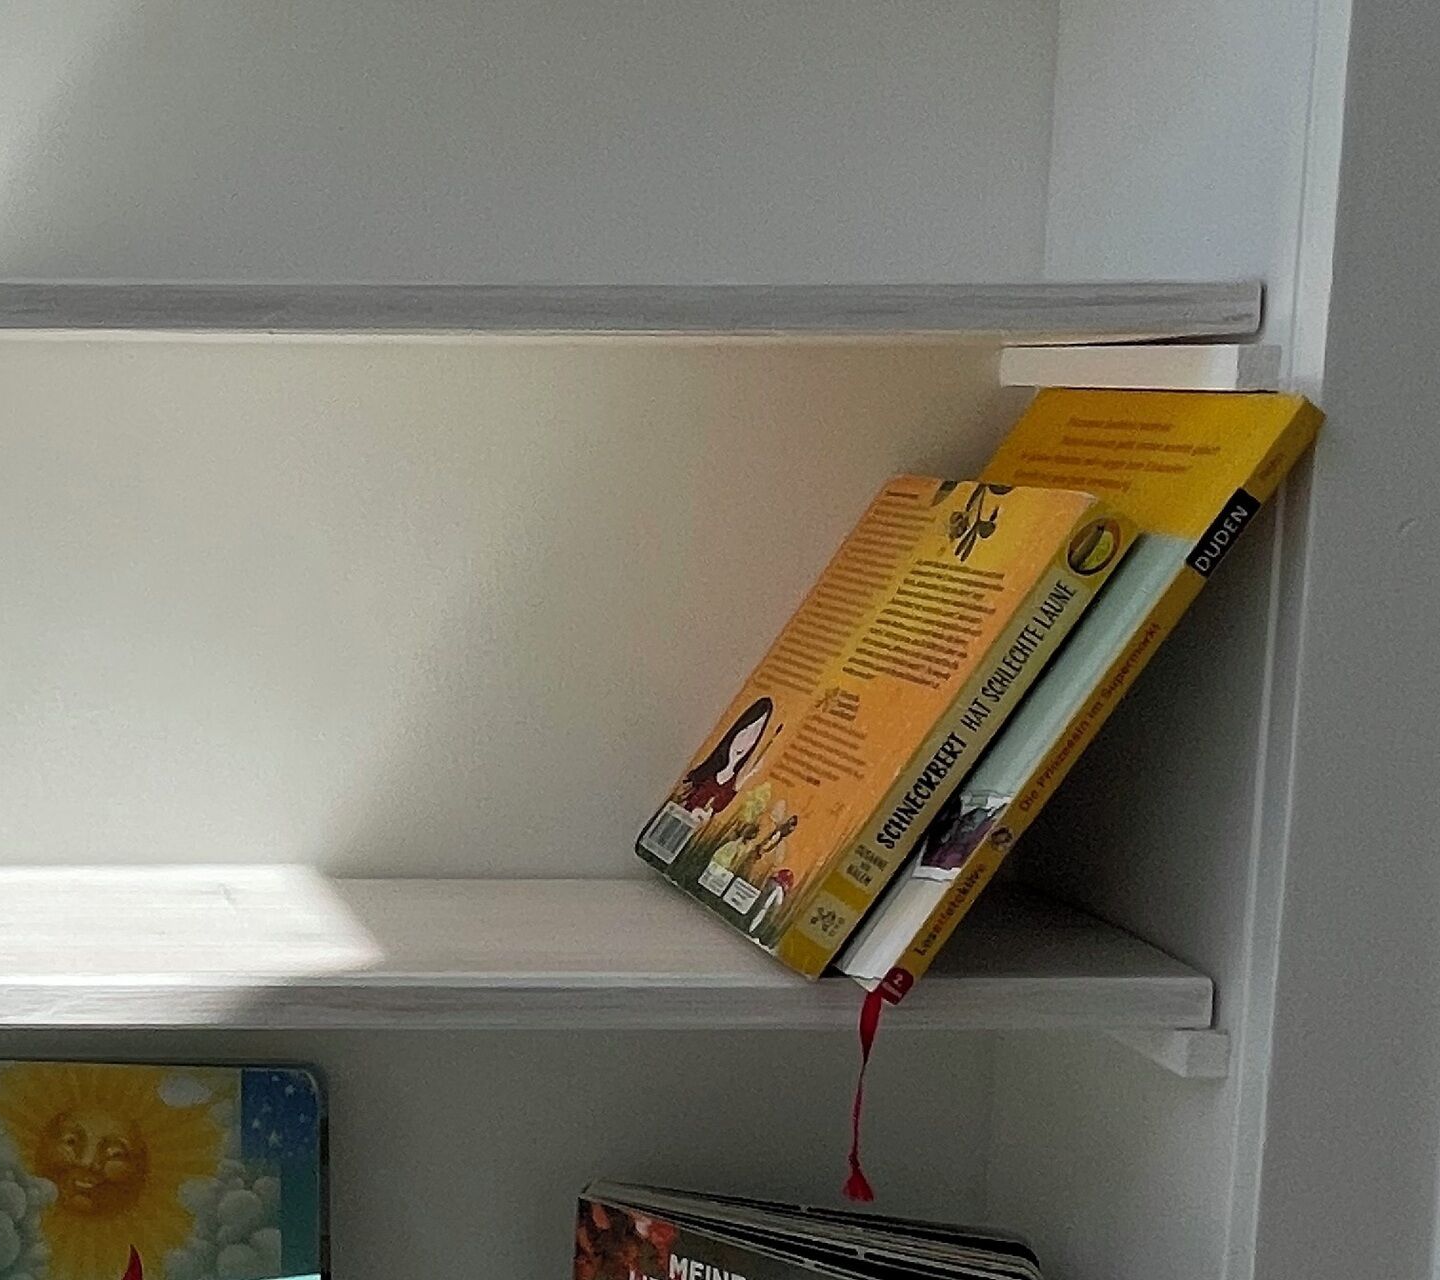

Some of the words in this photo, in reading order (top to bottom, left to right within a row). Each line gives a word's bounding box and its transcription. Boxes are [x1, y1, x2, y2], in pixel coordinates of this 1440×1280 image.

[1194, 505, 1248, 572] DUDEN
[877, 731, 967, 849] SCHNECKBERT
[960, 697, 991, 732] HAT
[981, 626, 1044, 702] SCHLECHTE
[1035, 579, 1077, 631] LAUNE
